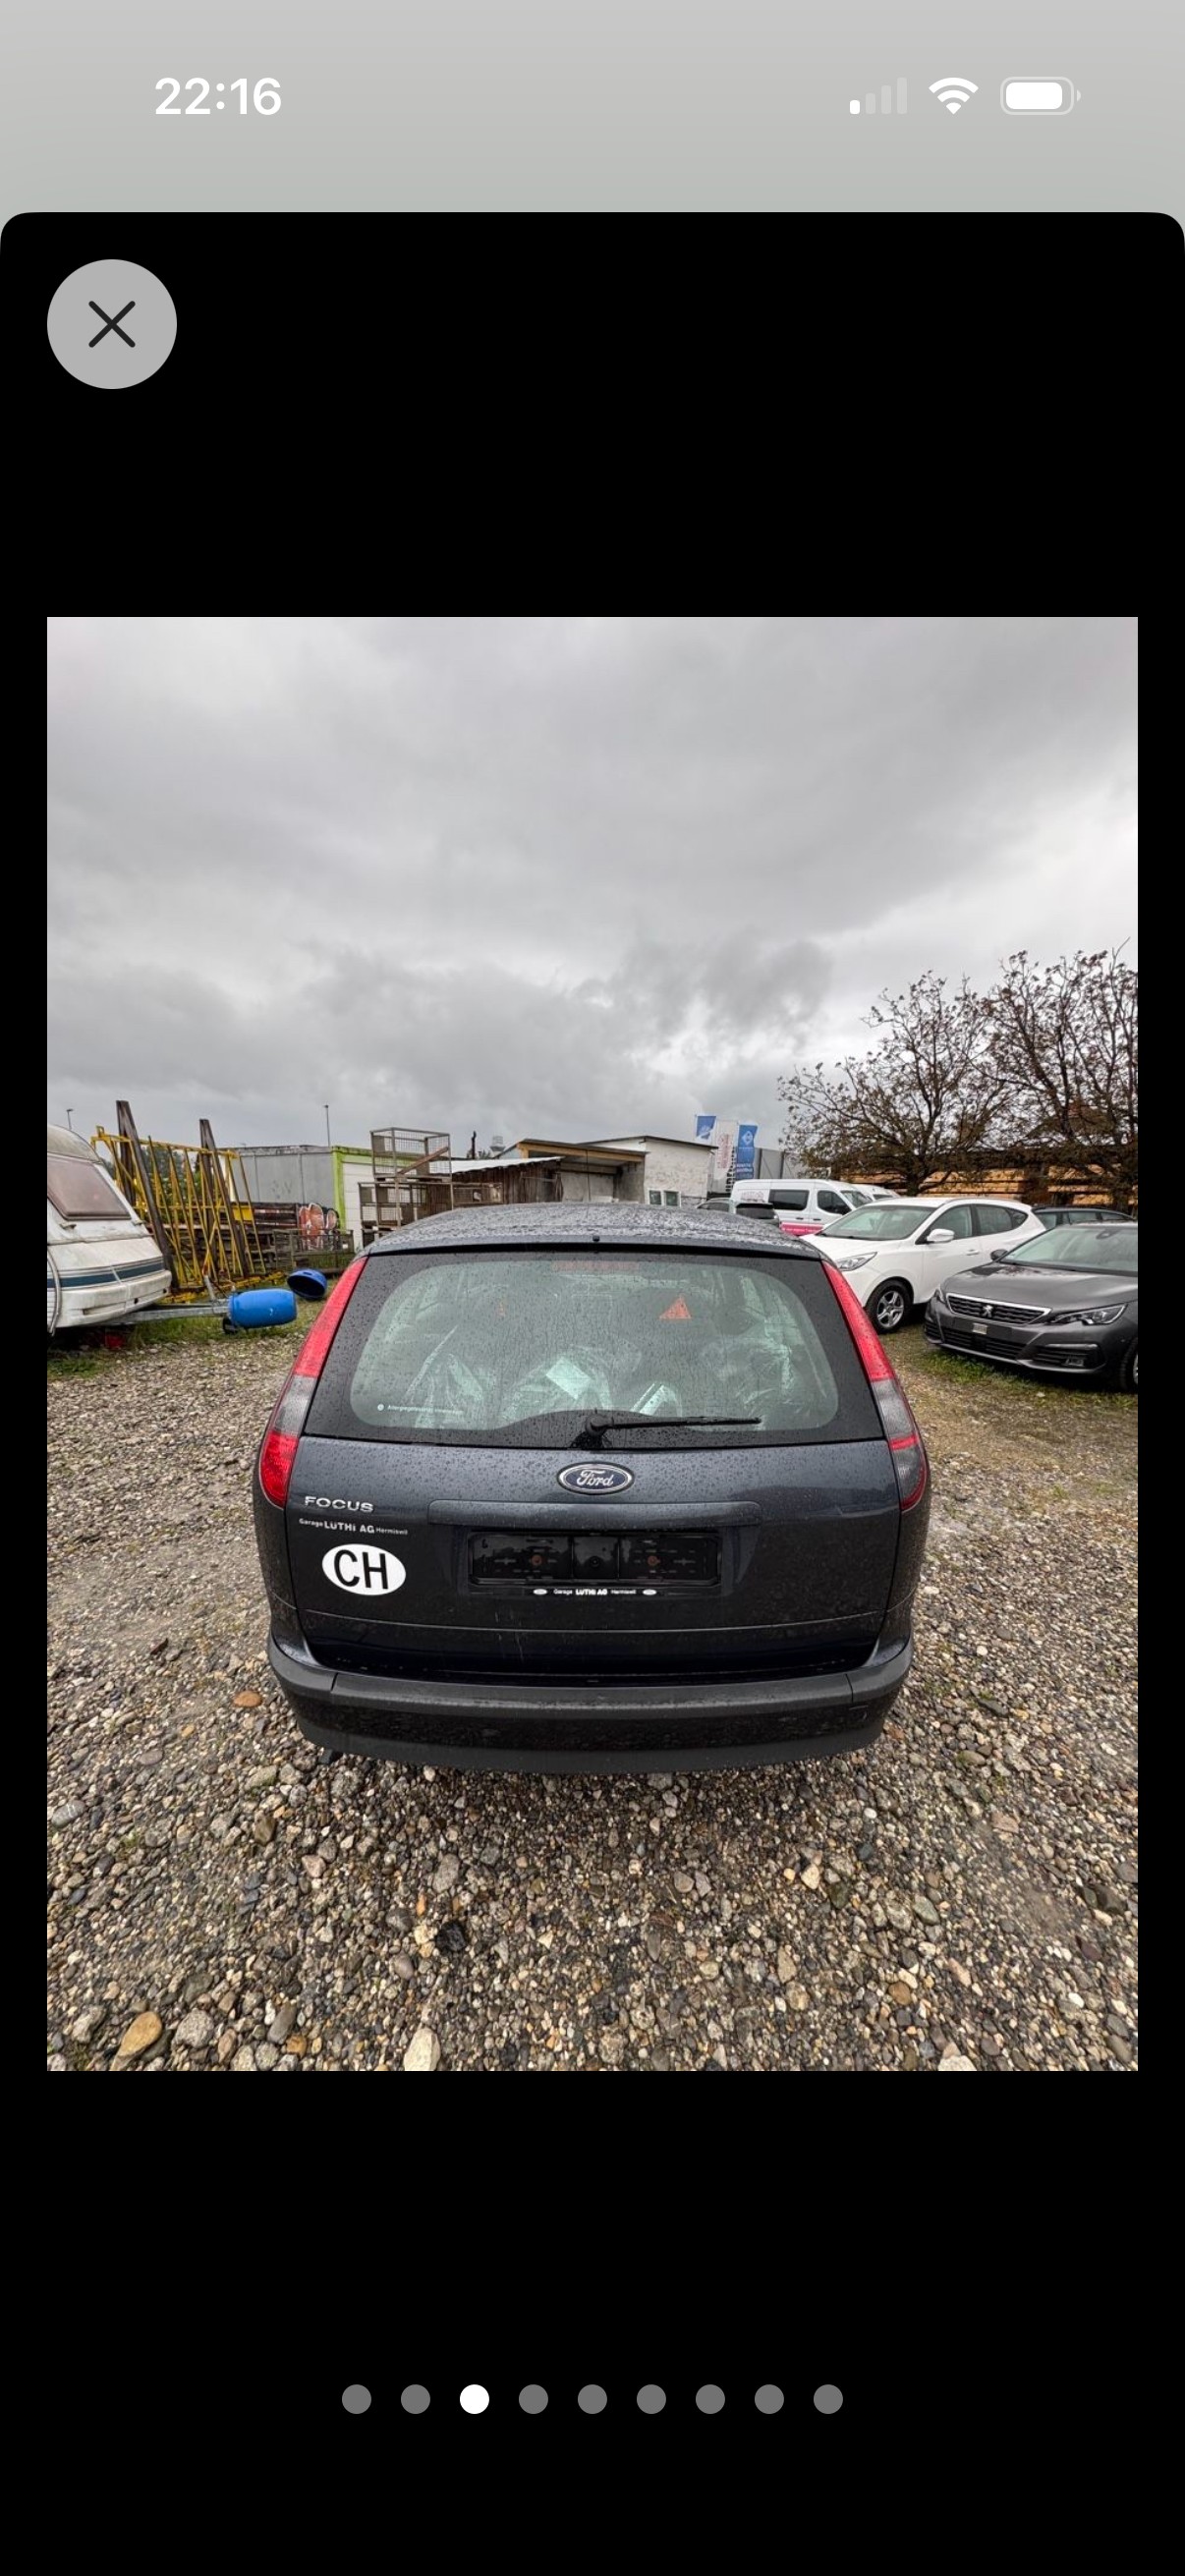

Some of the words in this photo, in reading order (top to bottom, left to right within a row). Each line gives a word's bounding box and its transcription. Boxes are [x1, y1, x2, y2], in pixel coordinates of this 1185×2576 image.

[576, 1469, 614, 1486] Ford
[305, 1496, 373, 1513] FOCUS
[299, 1518, 323, 1528] Garage
[360, 1525, 375, 1534] AG
[334, 1549, 389, 1590] CH
